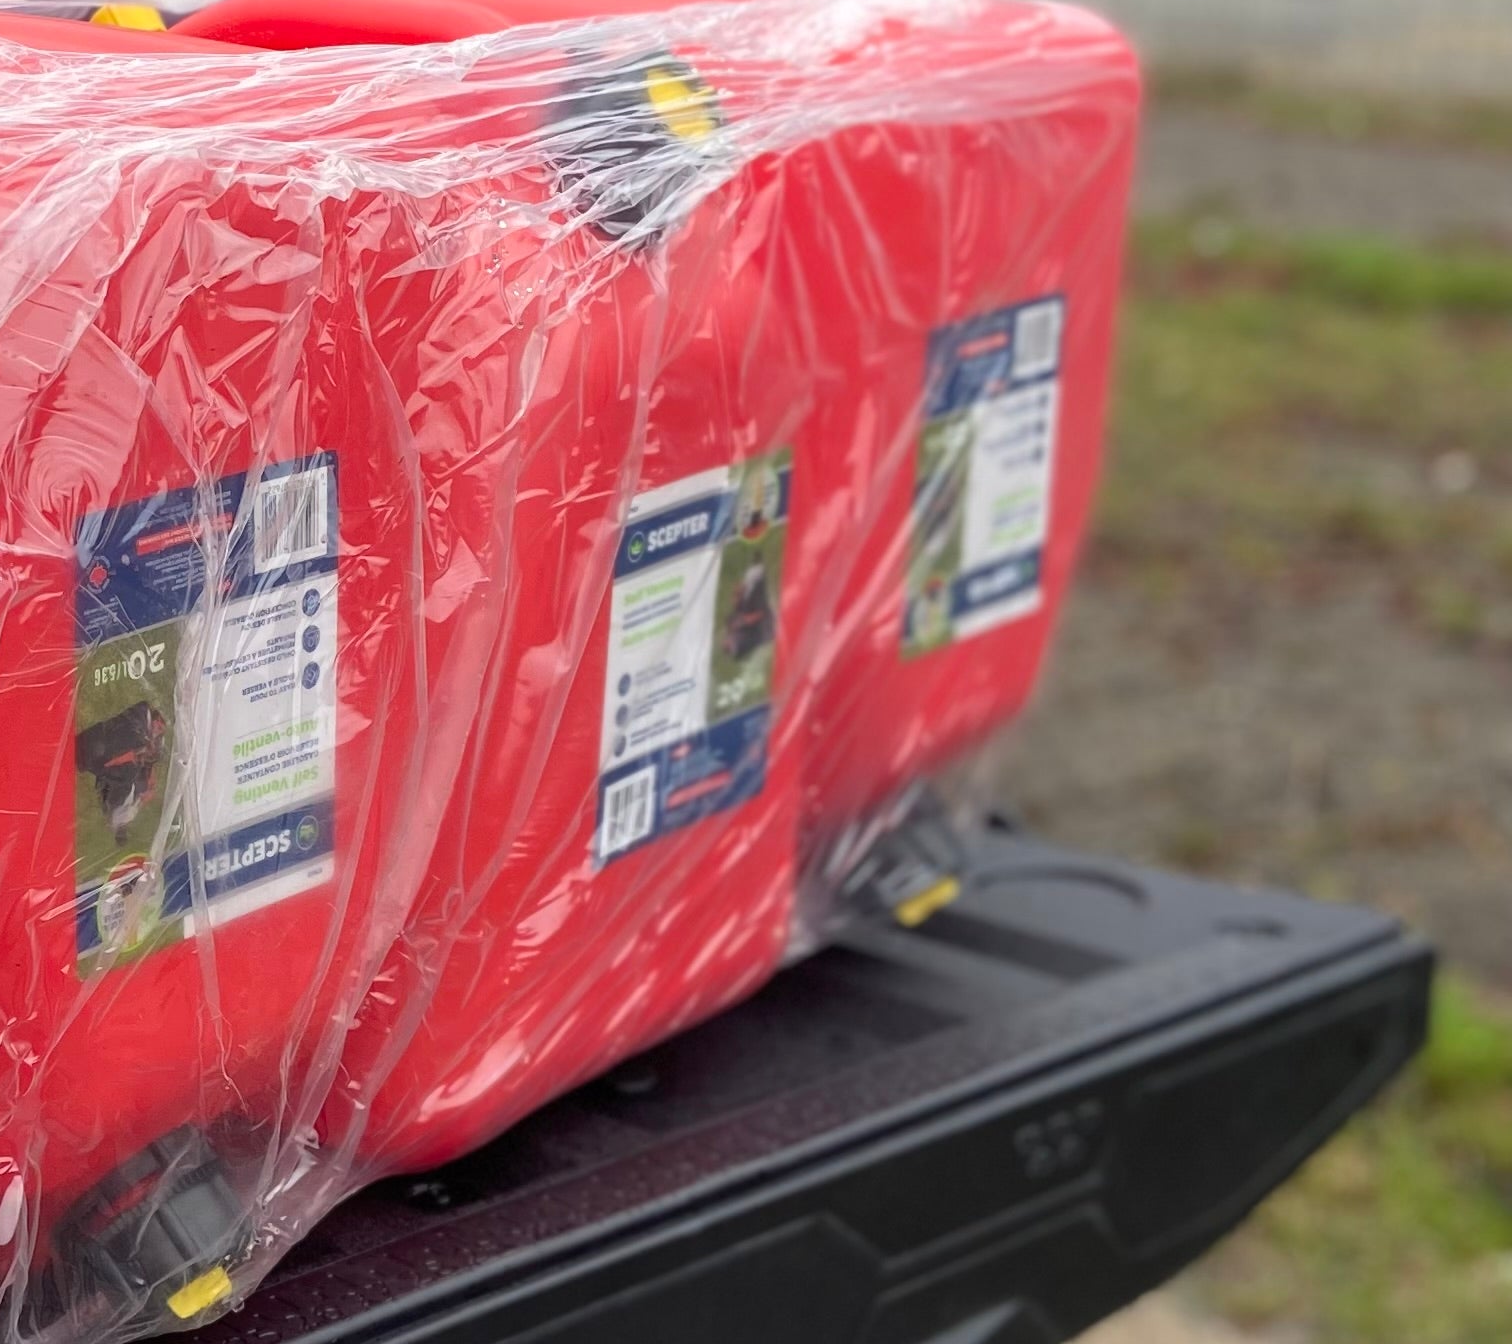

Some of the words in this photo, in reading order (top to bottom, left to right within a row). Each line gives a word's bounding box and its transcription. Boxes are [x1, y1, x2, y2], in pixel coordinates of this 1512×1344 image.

[648, 512, 709, 551] SCEPTER
[128, 642, 165, 680] 20
[205, 829, 291, 881] SCEPTER
